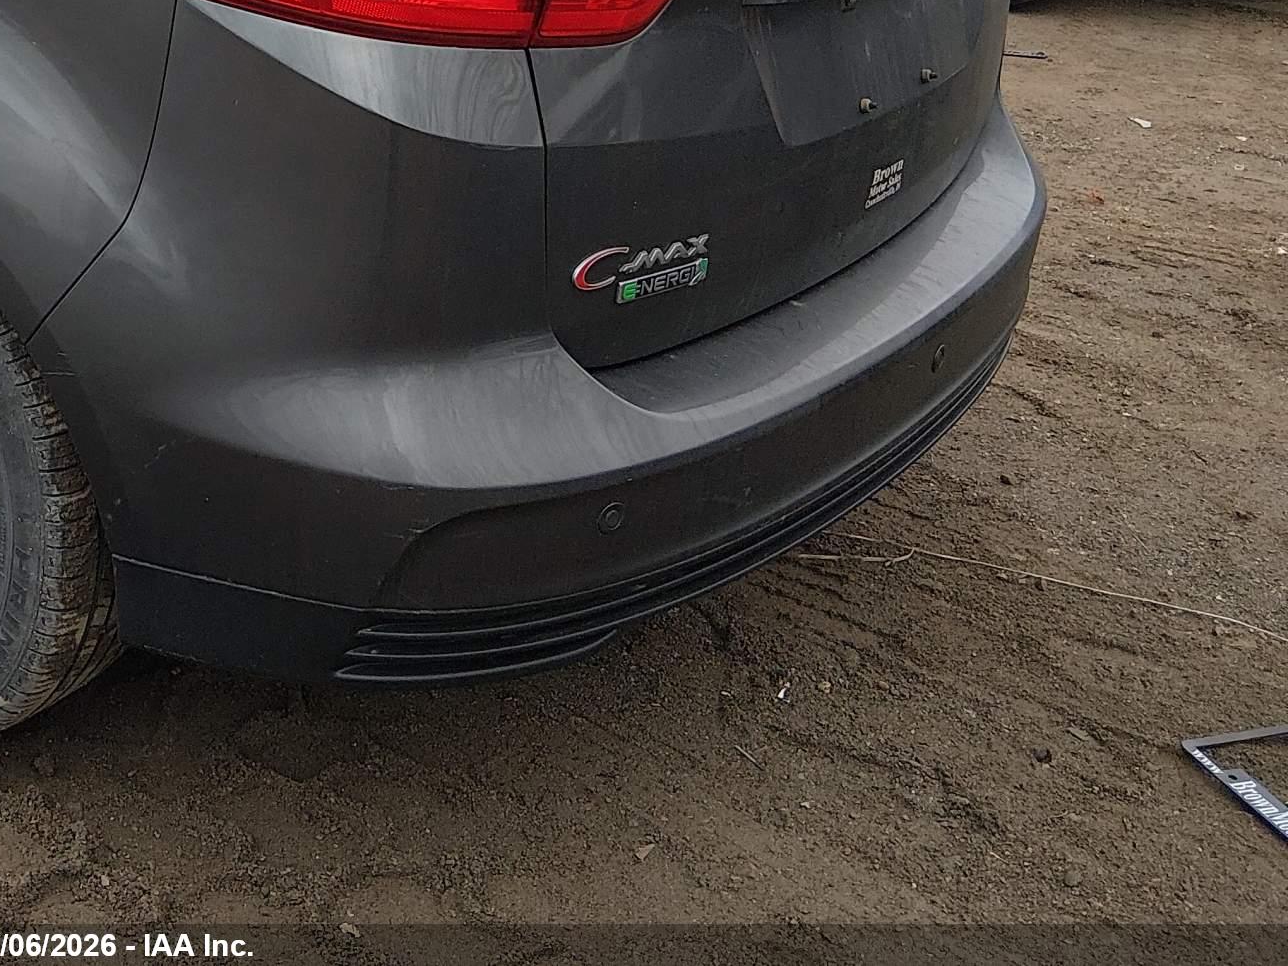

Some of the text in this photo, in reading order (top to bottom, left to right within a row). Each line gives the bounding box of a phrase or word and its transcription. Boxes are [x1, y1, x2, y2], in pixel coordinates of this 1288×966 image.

[871, 158, 905, 186] Brown
[621, 265, 697, 301] ENERGI
[1229, 780, 1280, 818] Brown
